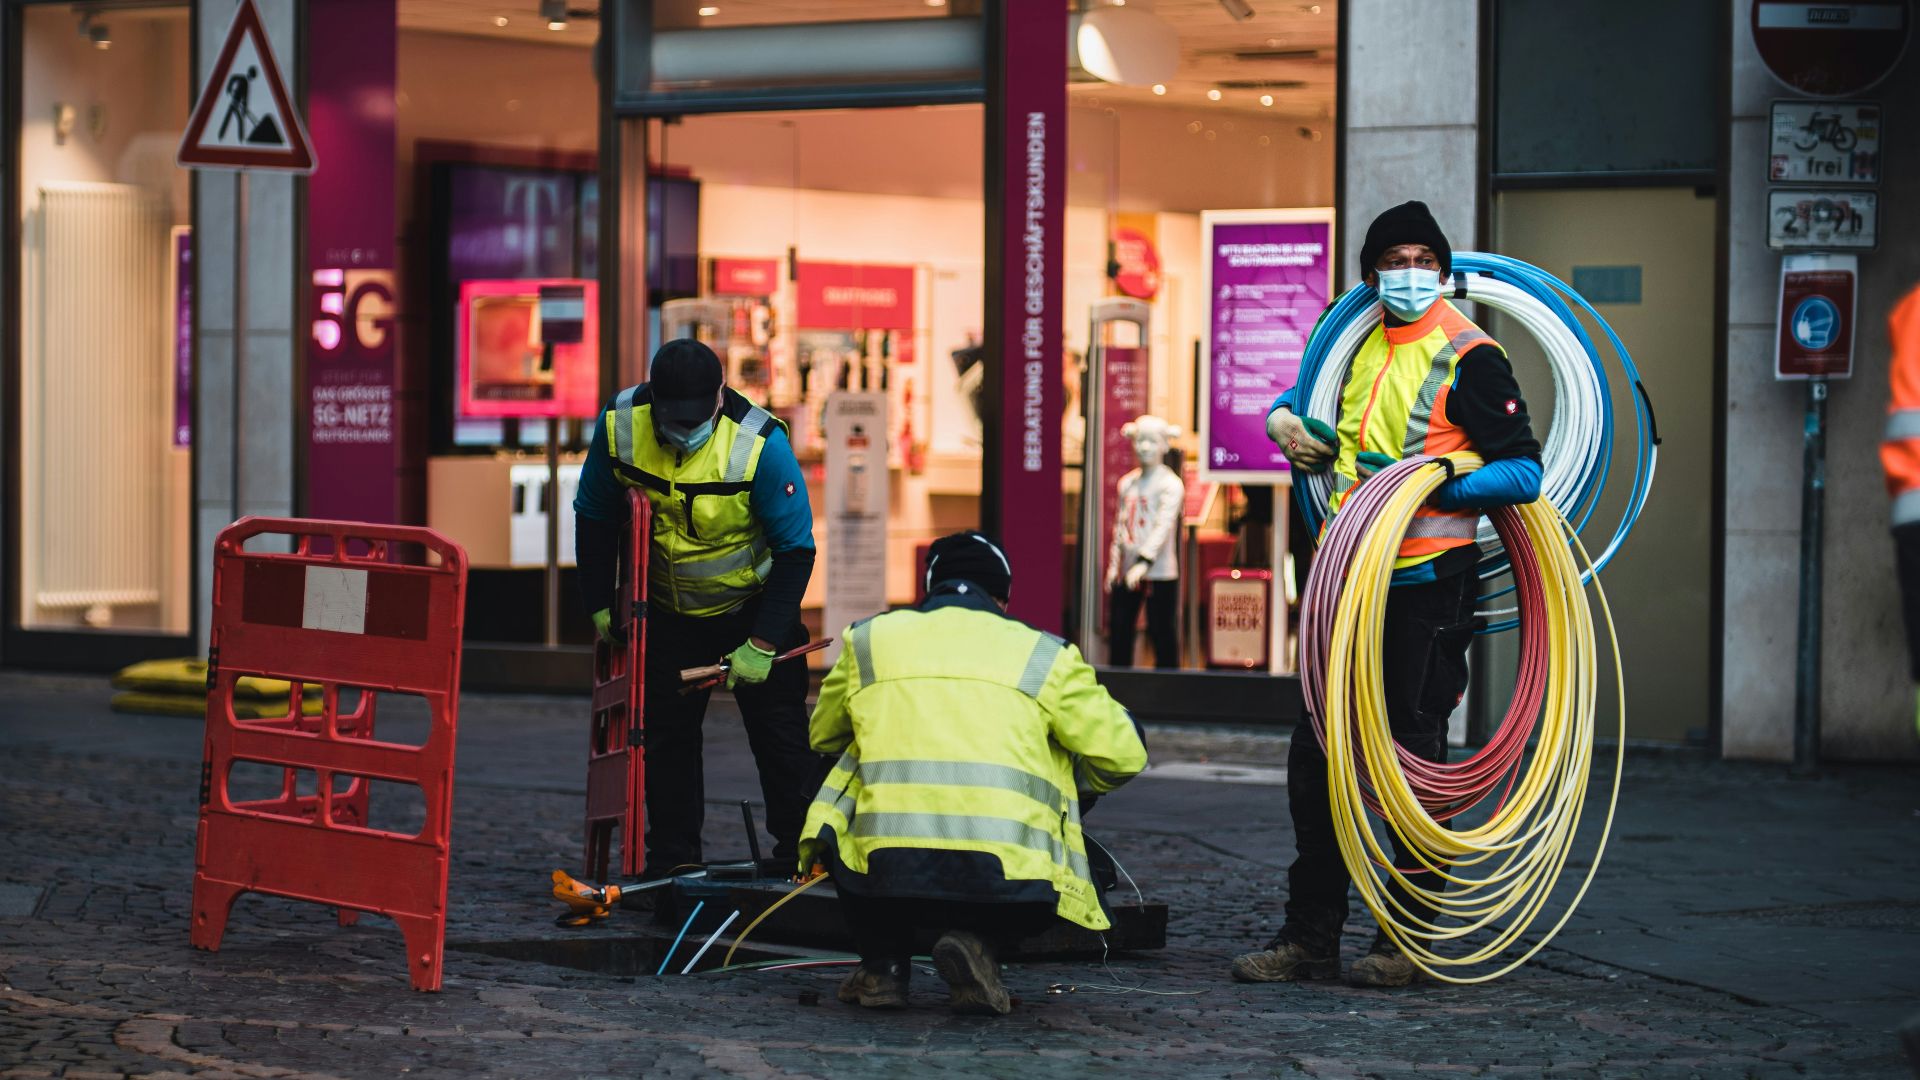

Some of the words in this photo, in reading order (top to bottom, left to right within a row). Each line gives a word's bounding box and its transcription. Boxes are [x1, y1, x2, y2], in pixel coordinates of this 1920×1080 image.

[1806, 156, 1842, 175] frei
[1023, 112, 1046, 315] GESCHÄFTSKUNDEN
[312, 268, 396, 351] 5G
[1022, 317, 1044, 359] FÜR
[313, 403, 391, 427] 5G-NETZ
[1024, 361, 1044, 472] BERATUNG
